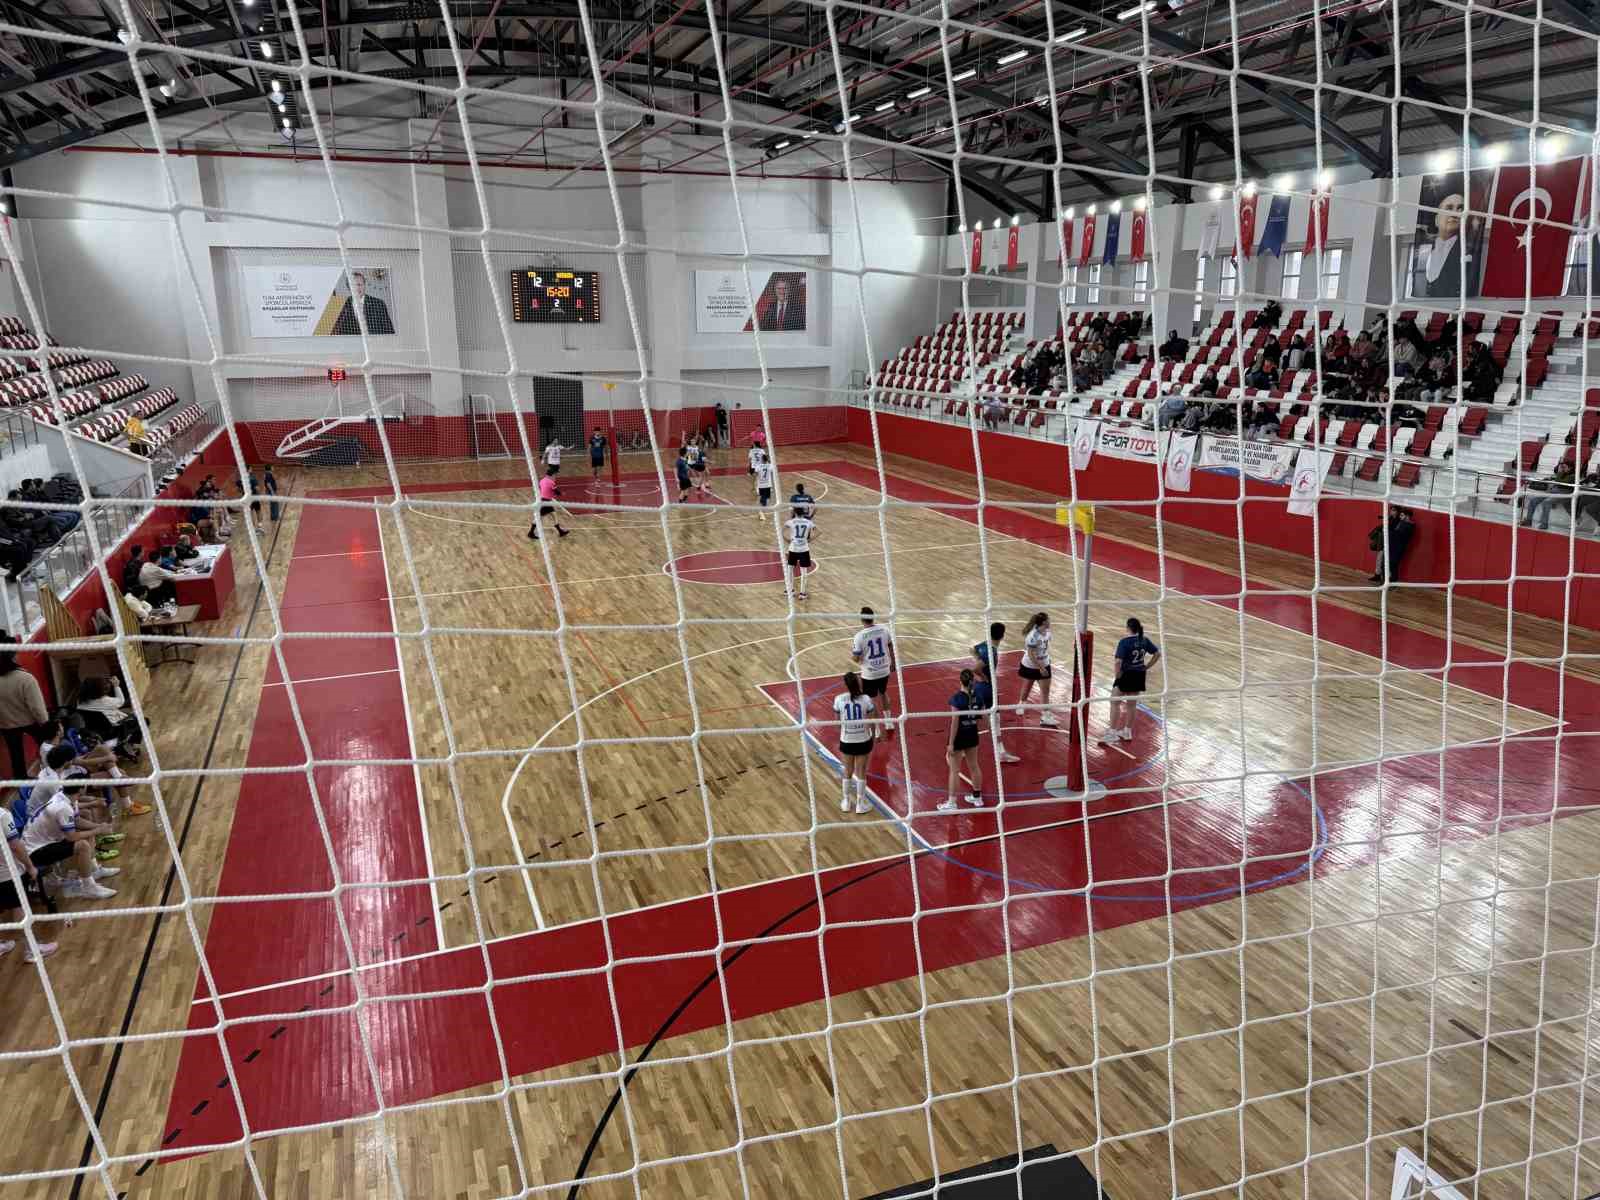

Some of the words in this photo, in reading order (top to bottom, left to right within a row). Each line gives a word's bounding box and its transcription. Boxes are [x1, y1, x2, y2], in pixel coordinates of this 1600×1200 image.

[533, 277, 542, 287] 12
[574, 278, 583, 288] 12
[546, 287, 569, 297] 15:20
[795, 524, 807, 538] 17
[867, 637, 885, 660] 11
[845, 703, 862, 721] 10
